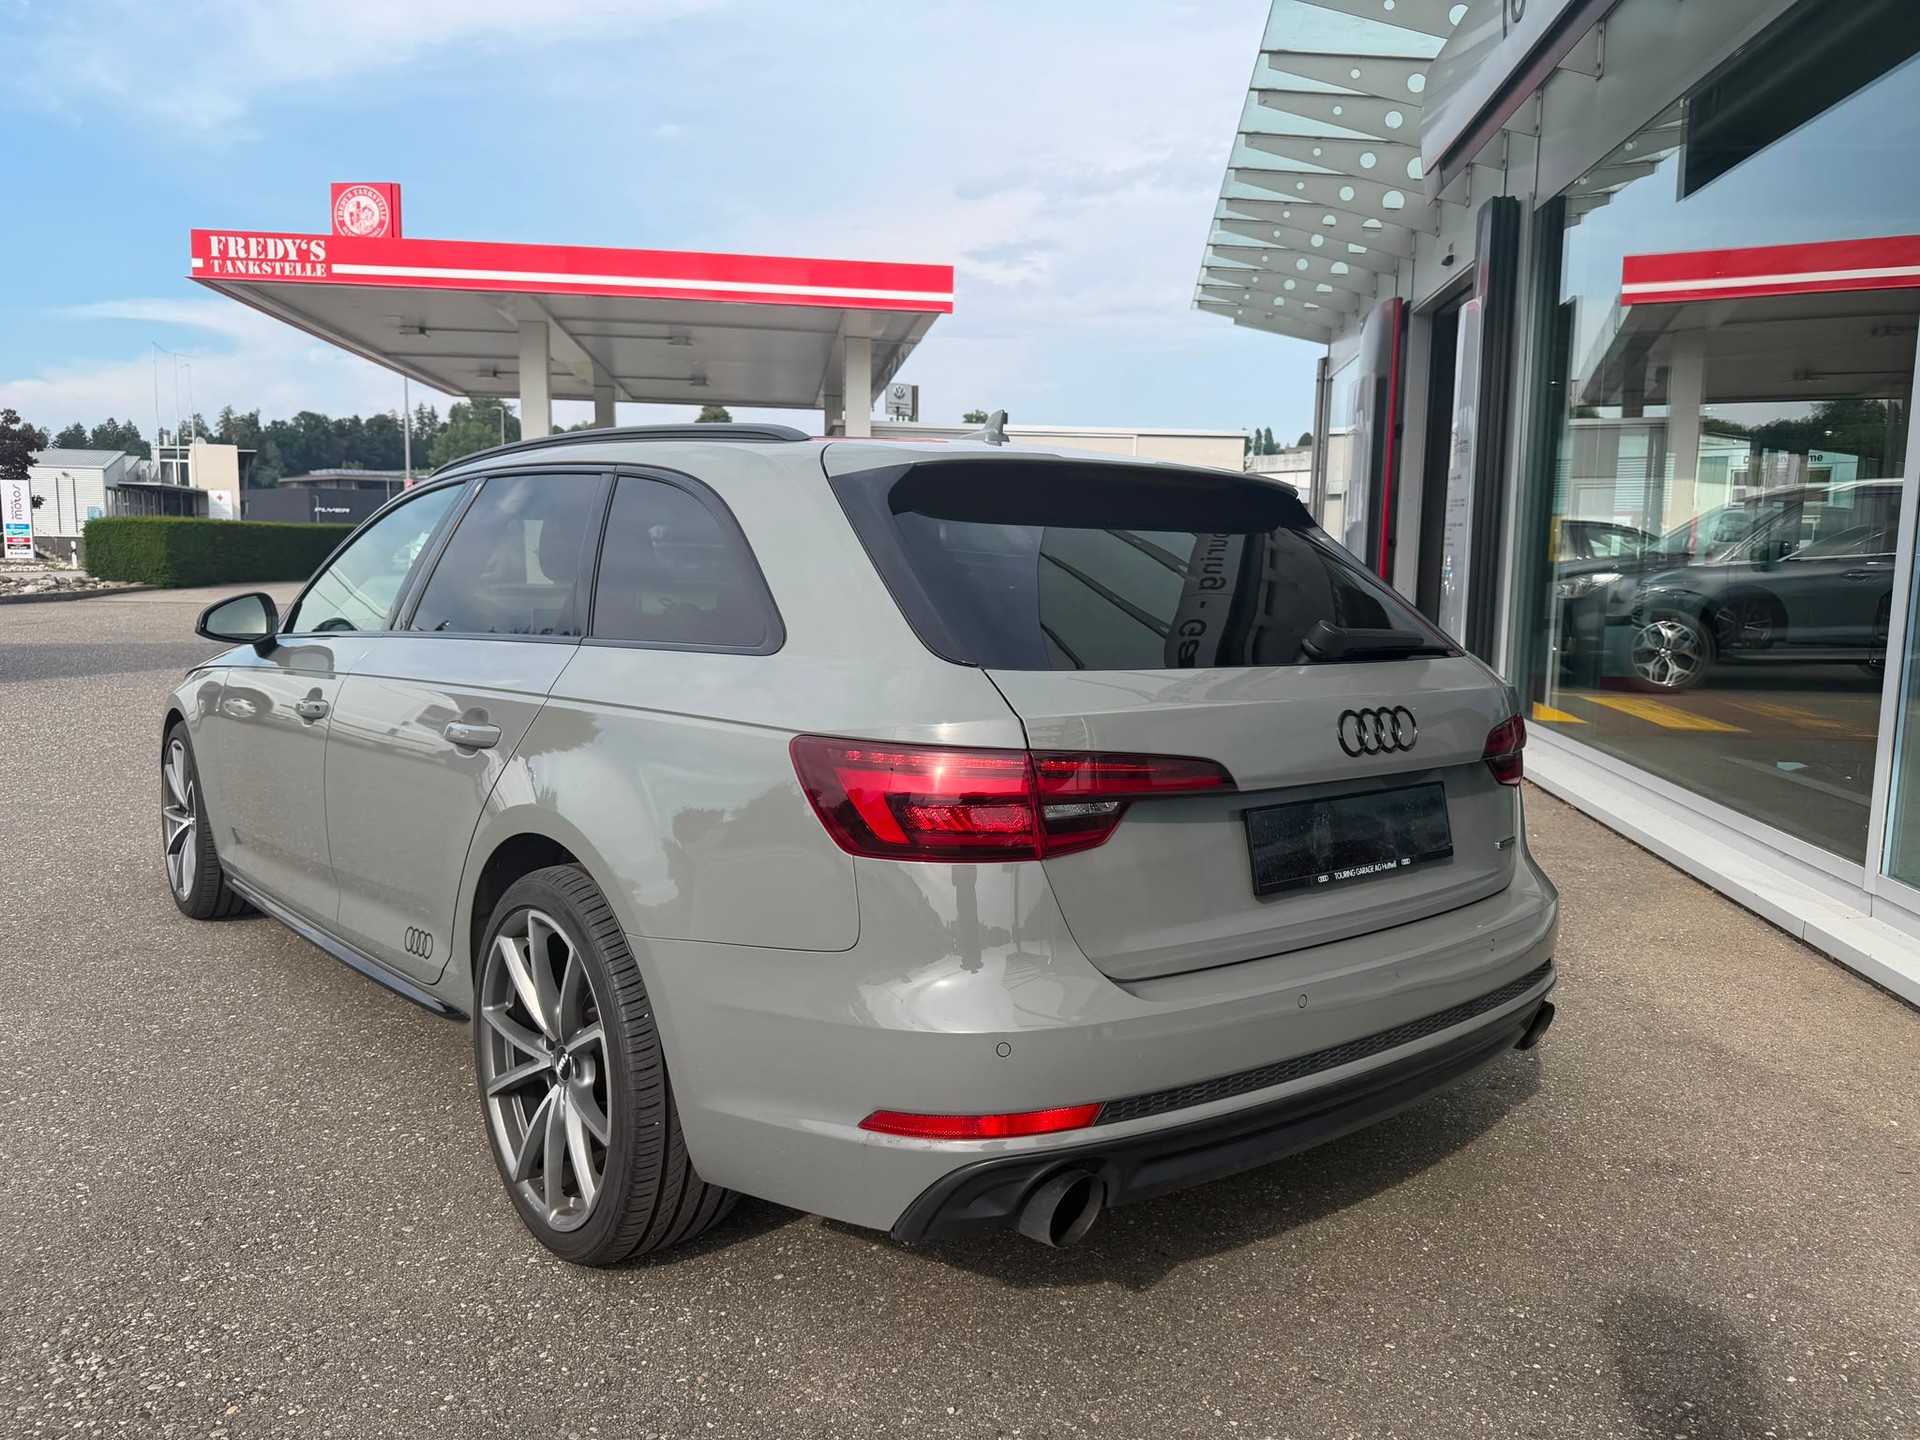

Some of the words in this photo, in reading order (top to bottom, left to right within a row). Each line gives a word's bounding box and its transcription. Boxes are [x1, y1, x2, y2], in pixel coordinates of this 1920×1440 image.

[210, 260, 327, 277] TANKSTELLE
[1334, 870, 1355, 880] TOURING
[1356, 865, 1374, 875] GARAGE
